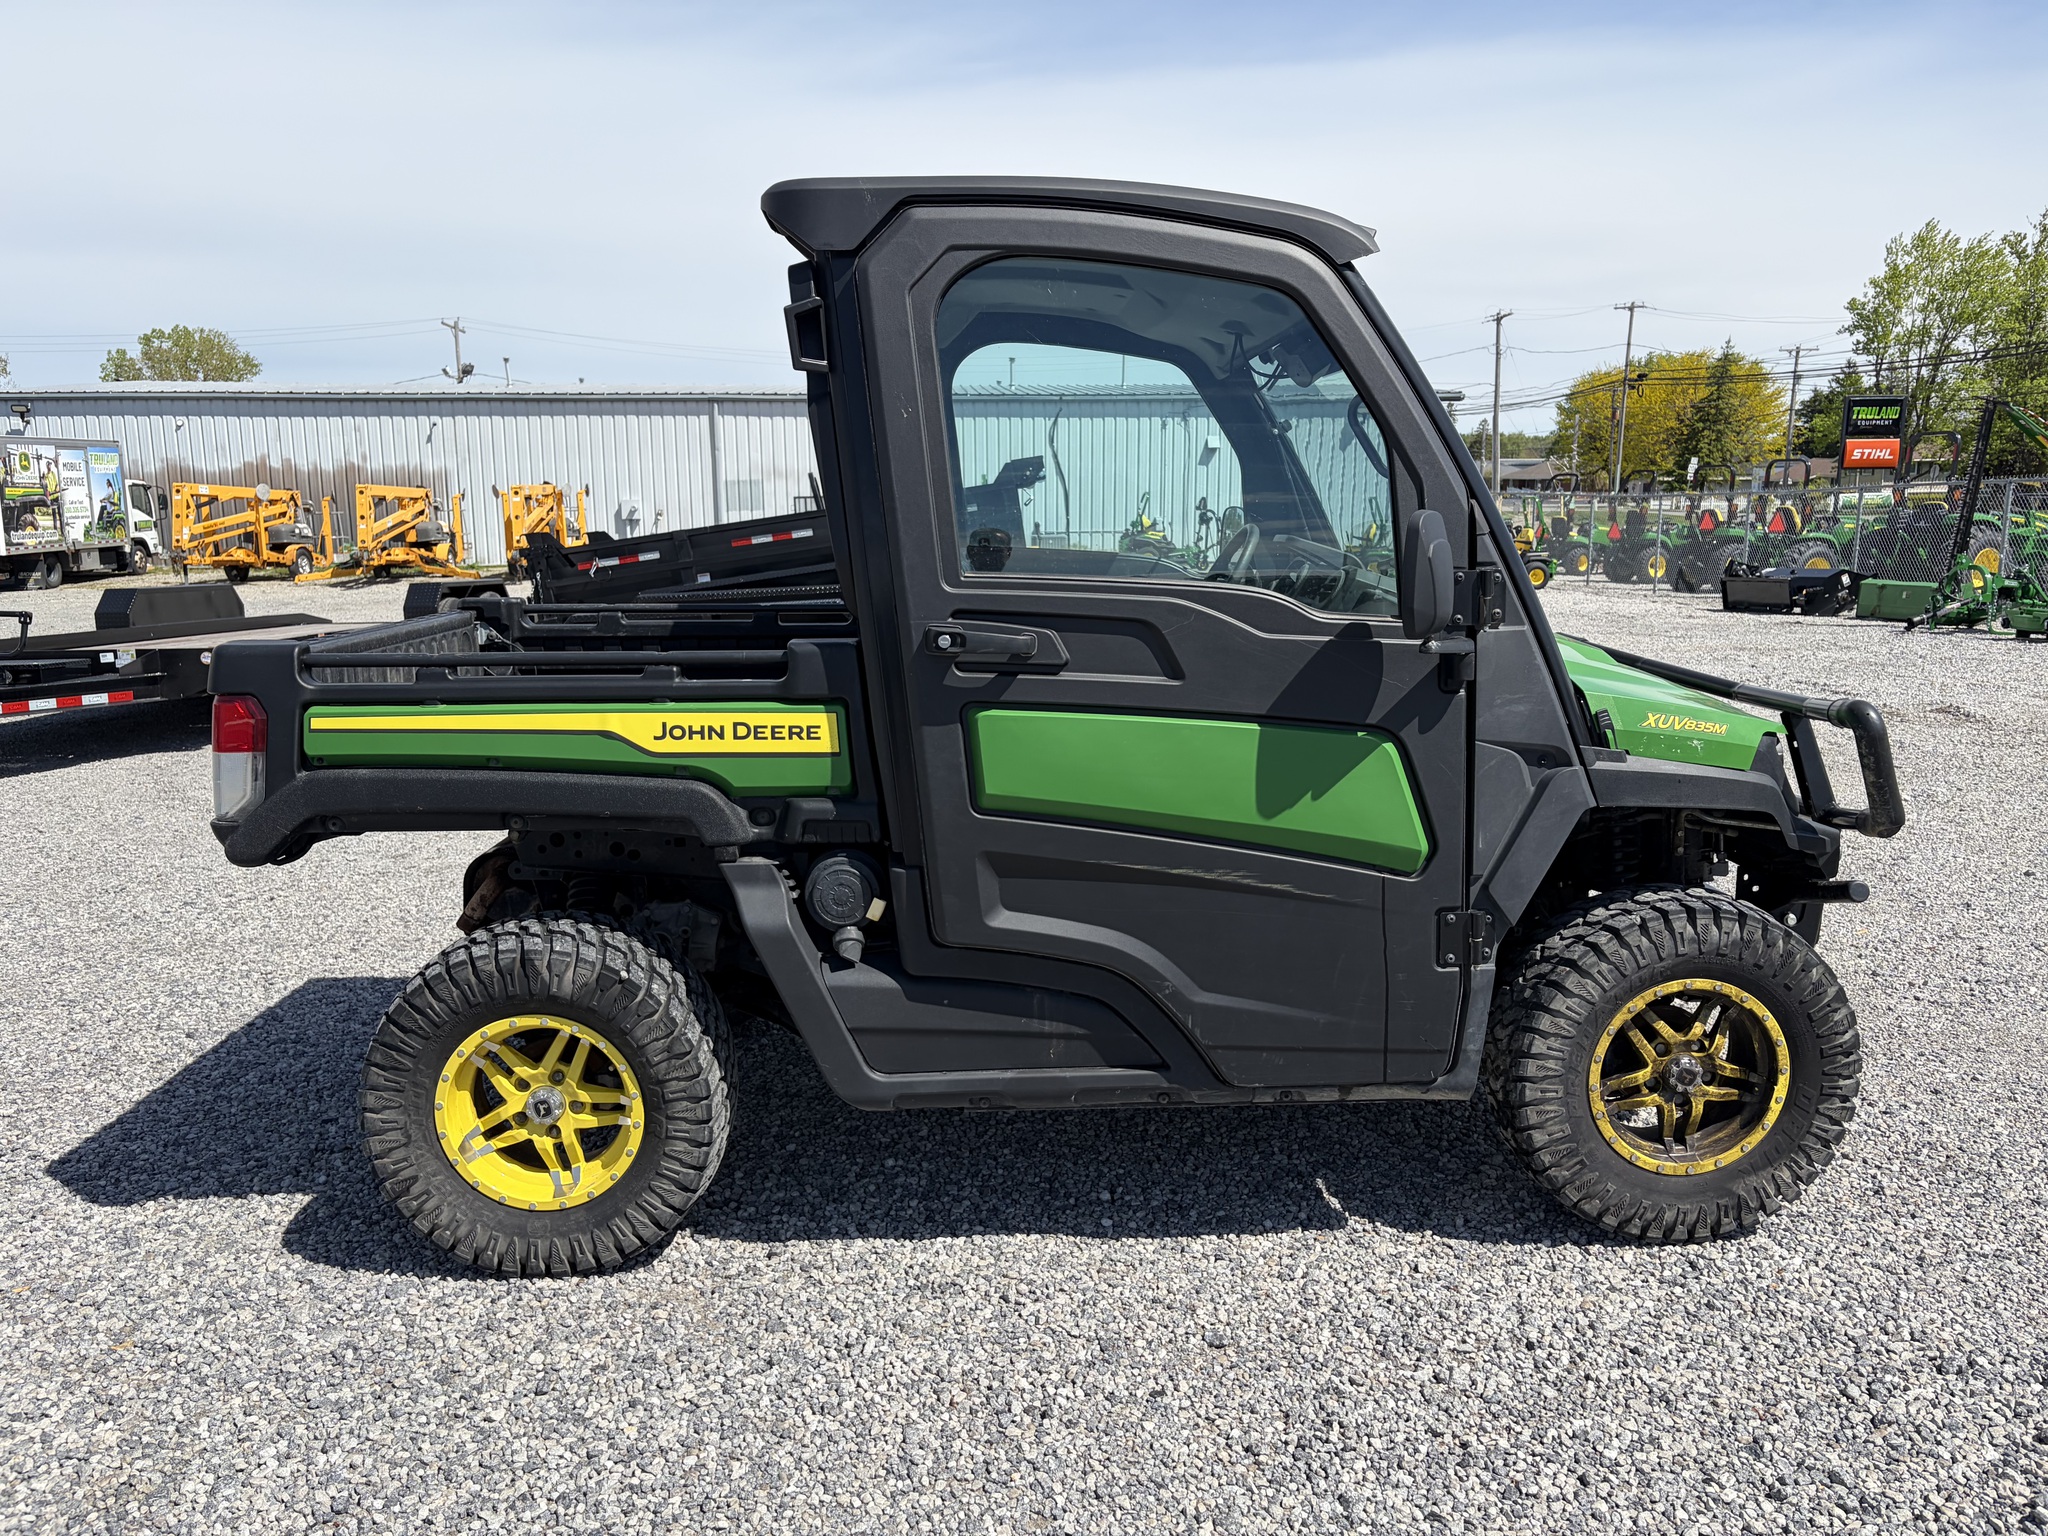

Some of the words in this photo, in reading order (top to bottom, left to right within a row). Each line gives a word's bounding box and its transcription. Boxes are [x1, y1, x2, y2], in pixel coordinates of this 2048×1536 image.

[1852, 406, 1901, 420] TRULAND
[89, 453, 118, 465] TRULAND
[1851, 448, 1894, 460] STIHL
[62, 461, 82, 472] MOBILE
[62, 476, 85, 487] SERVICE
[12, 531, 57, 541] trulandequip.com
[1640, 712, 1728, 735] XUV835M
[653, 721, 725, 741] JOHN
[732, 721, 822, 741] DEERE
